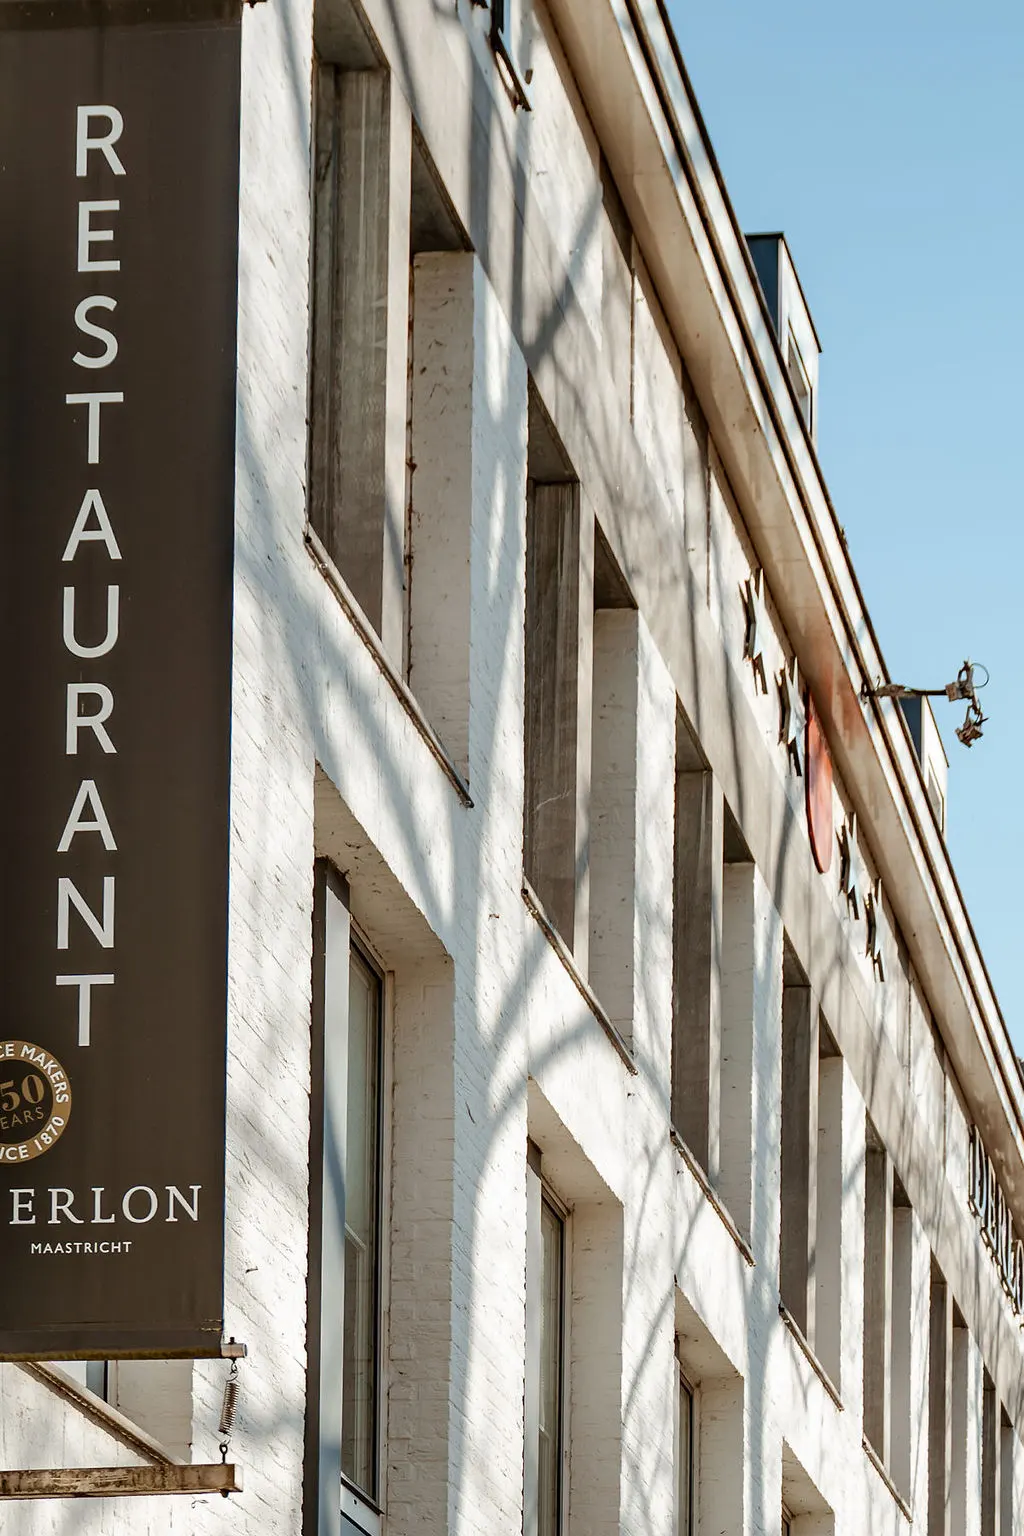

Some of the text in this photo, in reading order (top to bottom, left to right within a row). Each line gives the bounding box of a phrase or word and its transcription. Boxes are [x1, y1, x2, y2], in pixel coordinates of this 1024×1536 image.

[55, 104, 127, 1047] RESTAURANT
[20, 1045, 69, 1103] MAKERS
[34, 1116, 65, 1151] 1870
[31, 1241, 132, 1254] MAASTRICHT
